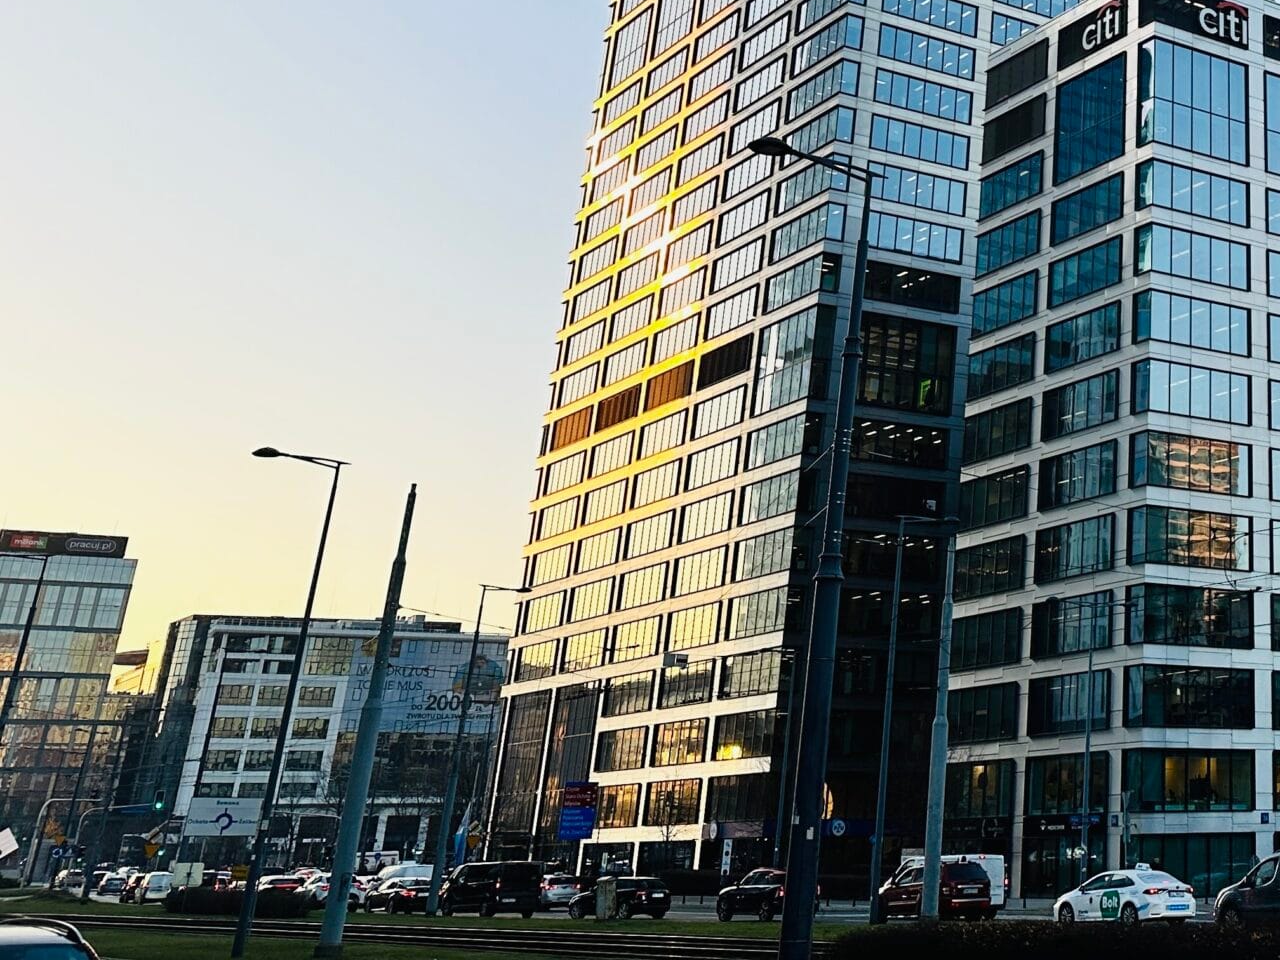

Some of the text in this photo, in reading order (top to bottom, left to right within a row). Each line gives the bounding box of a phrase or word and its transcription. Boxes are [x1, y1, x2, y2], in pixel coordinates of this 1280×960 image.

[1082, 4, 1121, 51] citi
[1200, 3, 1248, 45] citi
[69, 541, 112, 550] pracuj.pl
[397, 681, 424, 691] MUS
[1102, 895, 1118, 908] Bolt
